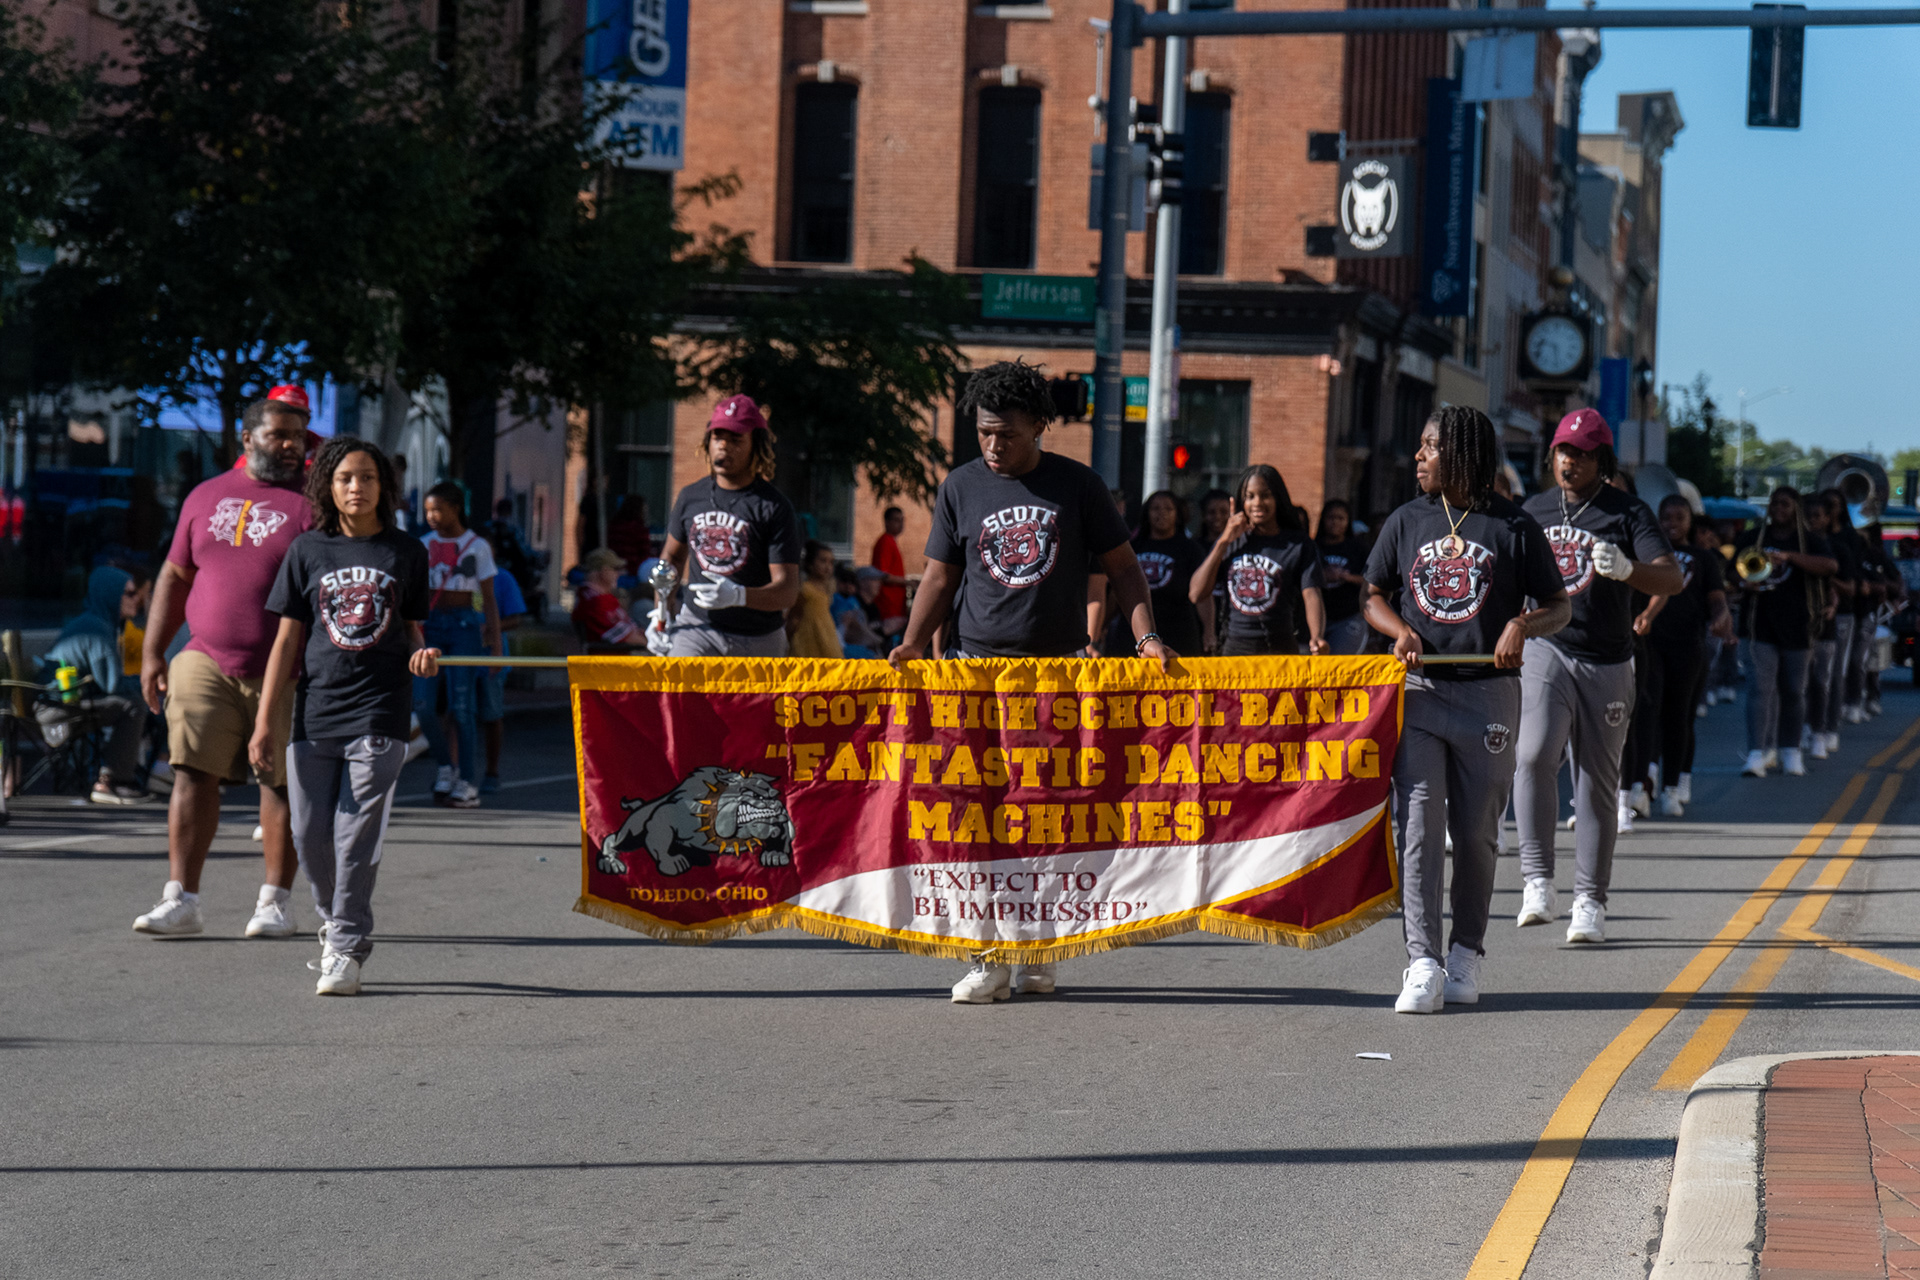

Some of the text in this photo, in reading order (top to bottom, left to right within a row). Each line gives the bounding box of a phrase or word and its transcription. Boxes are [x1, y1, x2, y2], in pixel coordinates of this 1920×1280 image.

[994, 280, 1082, 304] Jefferson
[693, 511, 749, 533] SCOTT
[982, 505, 1057, 534] SCOTT
[1419, 540, 1495, 564] SCTT
[1232, 554, 1282, 575] SCOTT
[321, 566, 396, 593] SCOTT
[1434, 608, 1470, 621] DANCING
[774, 688, 1370, 731] SCOTT HIGH SCHOOL BAND
[765, 738, 1381, 788] "FANTASTIC DANCING
[908, 800, 1232, 845] MACHINES"
[1059, 871, 1098, 892] TO
[626, 886, 768, 904] TOLEDO, OHIO
[914, 897, 951, 918] BE
